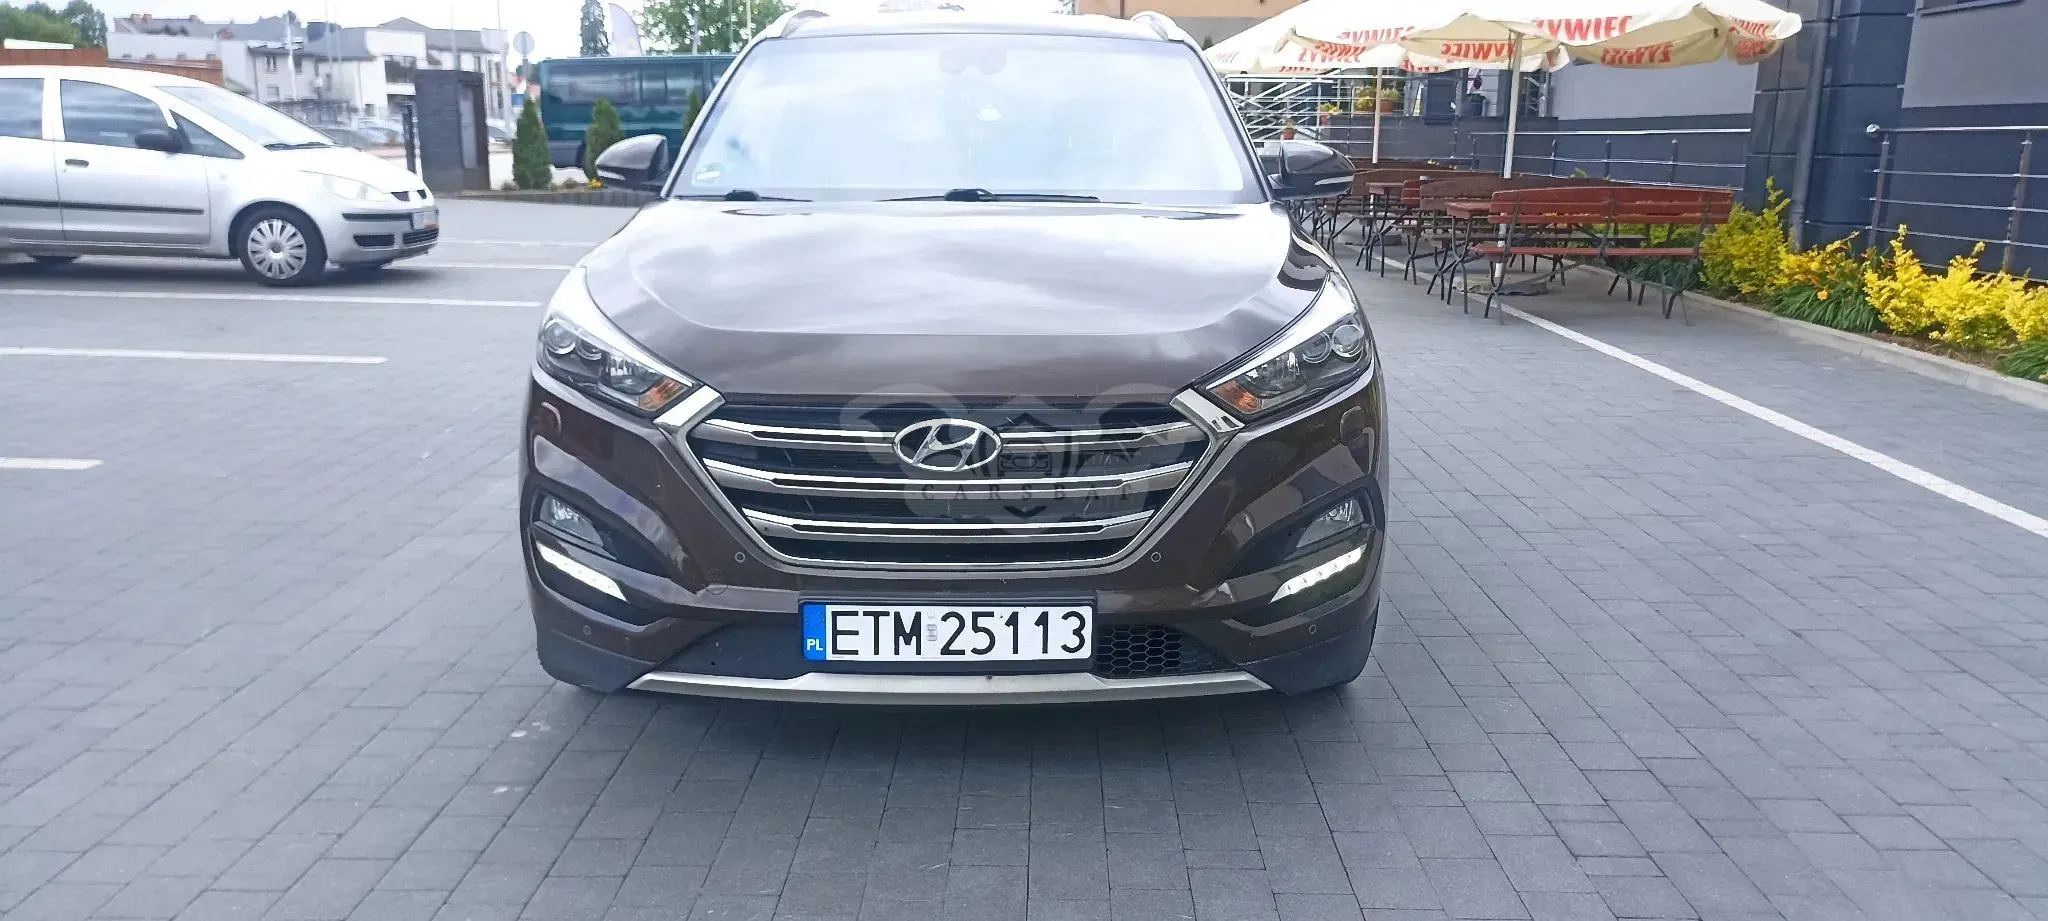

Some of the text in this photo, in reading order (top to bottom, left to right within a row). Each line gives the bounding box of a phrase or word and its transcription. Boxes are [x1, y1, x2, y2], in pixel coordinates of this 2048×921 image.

[806, 610, 1086, 656] PL ETM 25113
